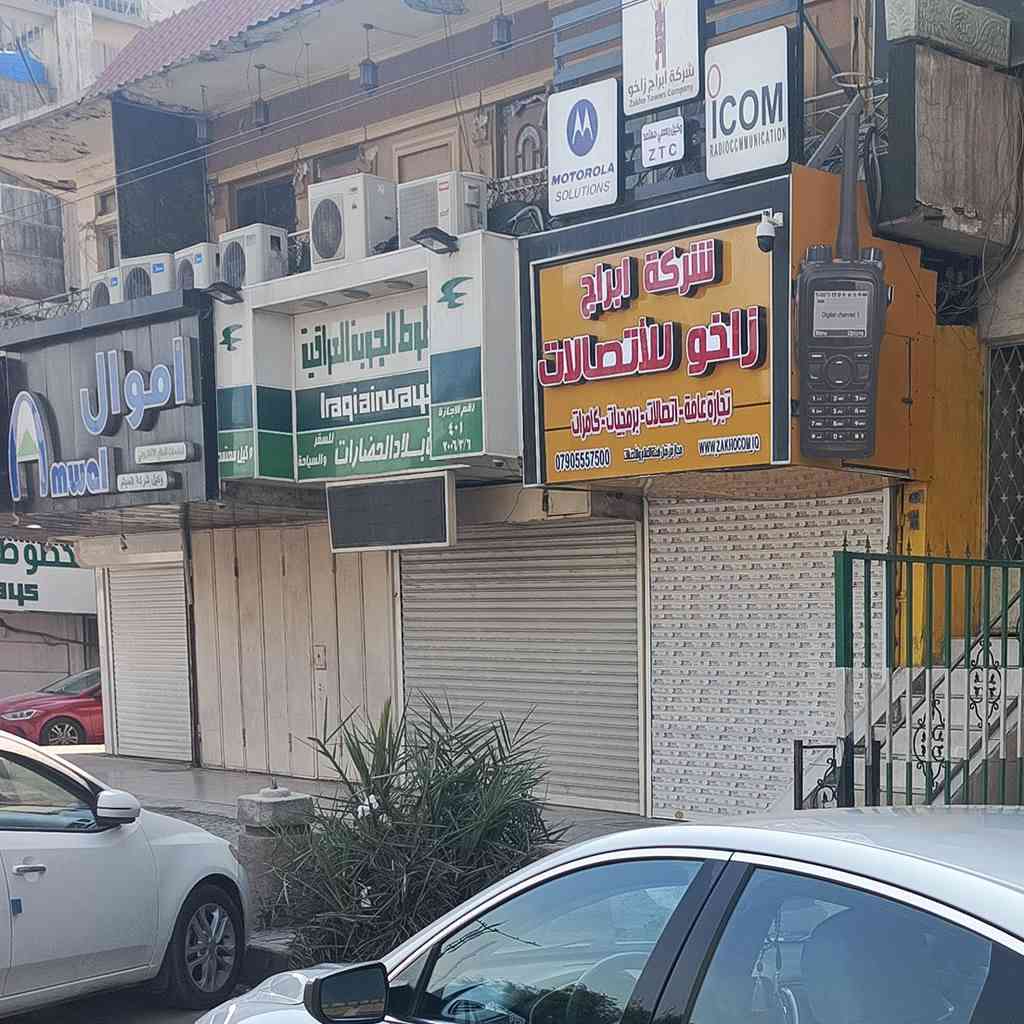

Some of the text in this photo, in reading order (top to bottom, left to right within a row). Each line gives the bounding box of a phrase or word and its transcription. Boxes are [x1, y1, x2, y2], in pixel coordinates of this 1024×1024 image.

[551, 162, 615, 186] MOTOROLA
[554, 181, 611, 203] SOLUTIONS
[580, 238, 715, 320] شركة ابراج
[687, 305, 760, 376] زاخو
[80, 336, 187, 435] اموال
[8, 391, 110, 501] Amwal
[554, 448, 611, 472] 07905557500
